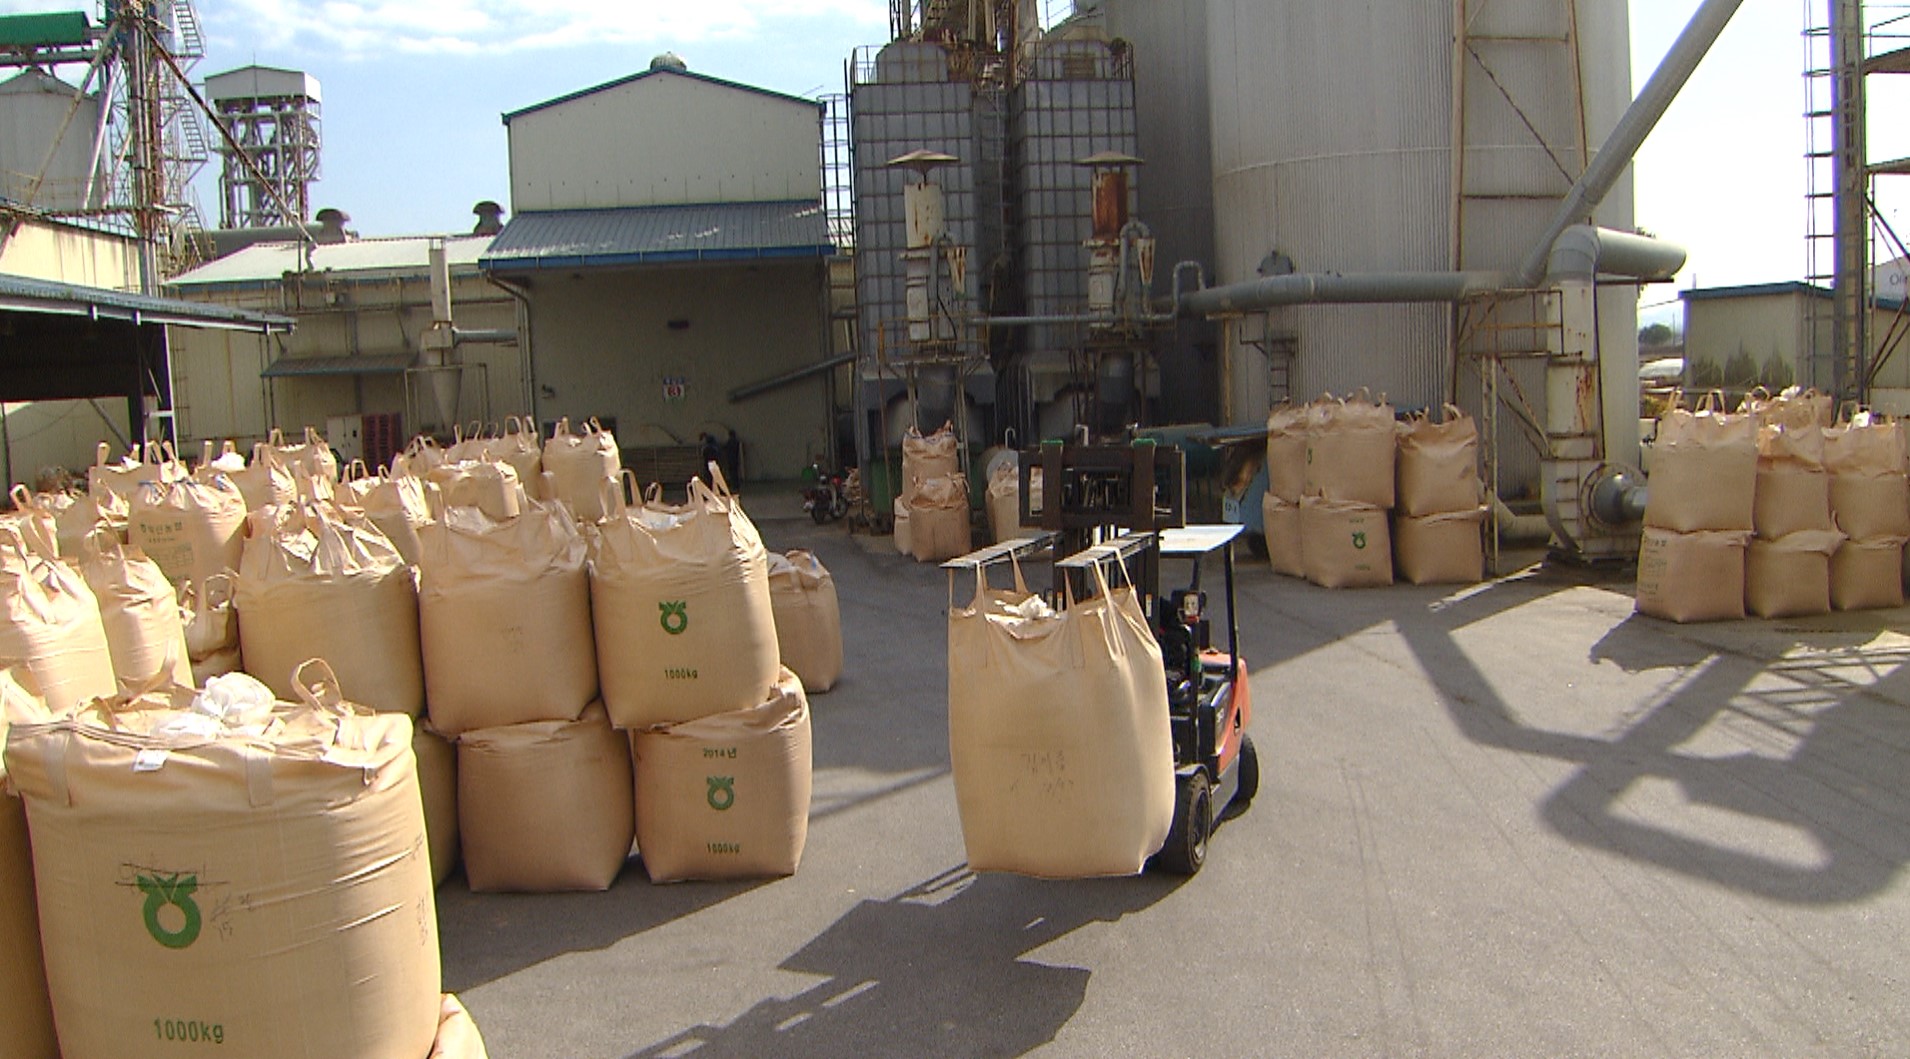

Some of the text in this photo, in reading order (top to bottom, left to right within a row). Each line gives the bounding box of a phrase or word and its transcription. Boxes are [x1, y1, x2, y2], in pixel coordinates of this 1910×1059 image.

[664, 668, 698, 679] 1000kg
[707, 842, 740, 855] 1000kg
[154, 1018, 224, 1044] 1000kg
